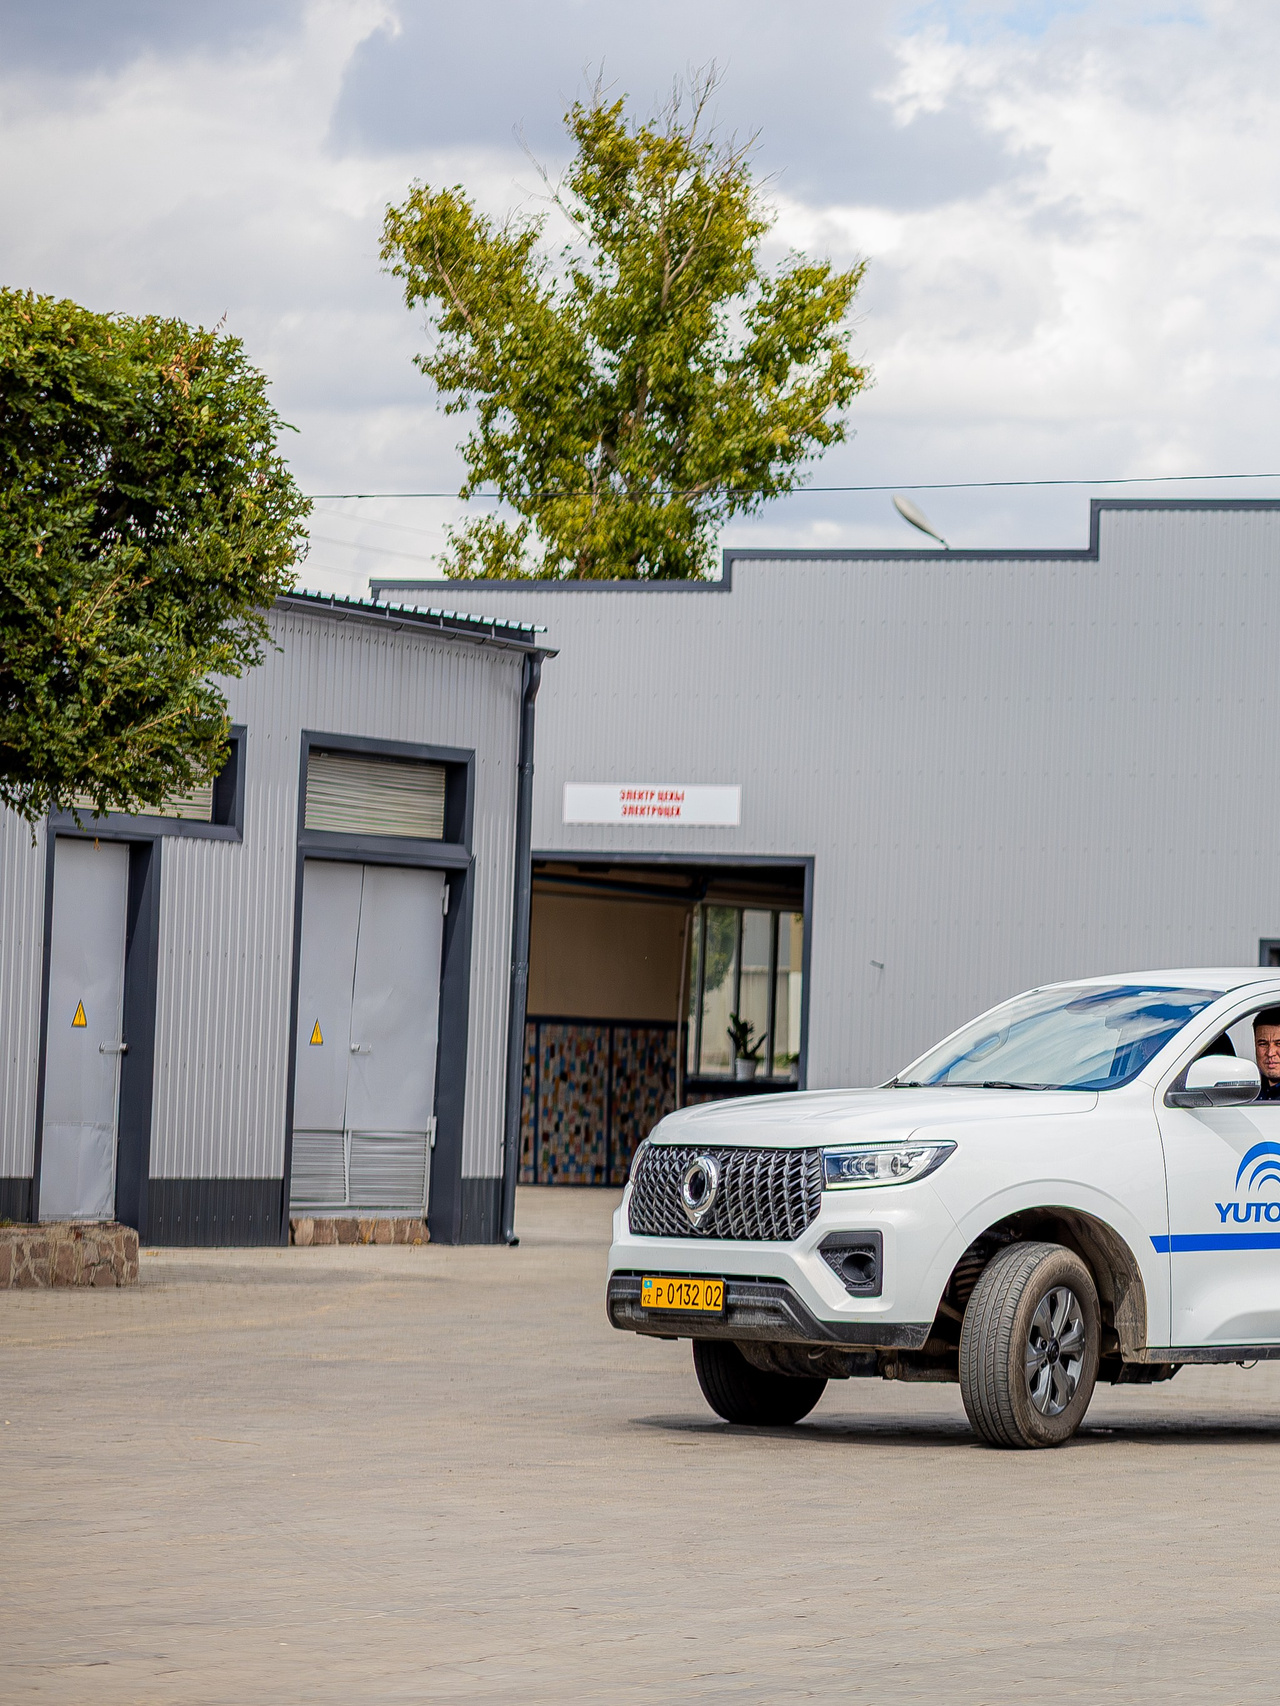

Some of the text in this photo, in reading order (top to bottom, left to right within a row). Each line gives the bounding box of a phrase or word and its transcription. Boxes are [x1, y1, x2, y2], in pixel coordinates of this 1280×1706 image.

[643, 1294, 651, 1304] KZ
[656, 1283, 722, 1307] P 0132 02
